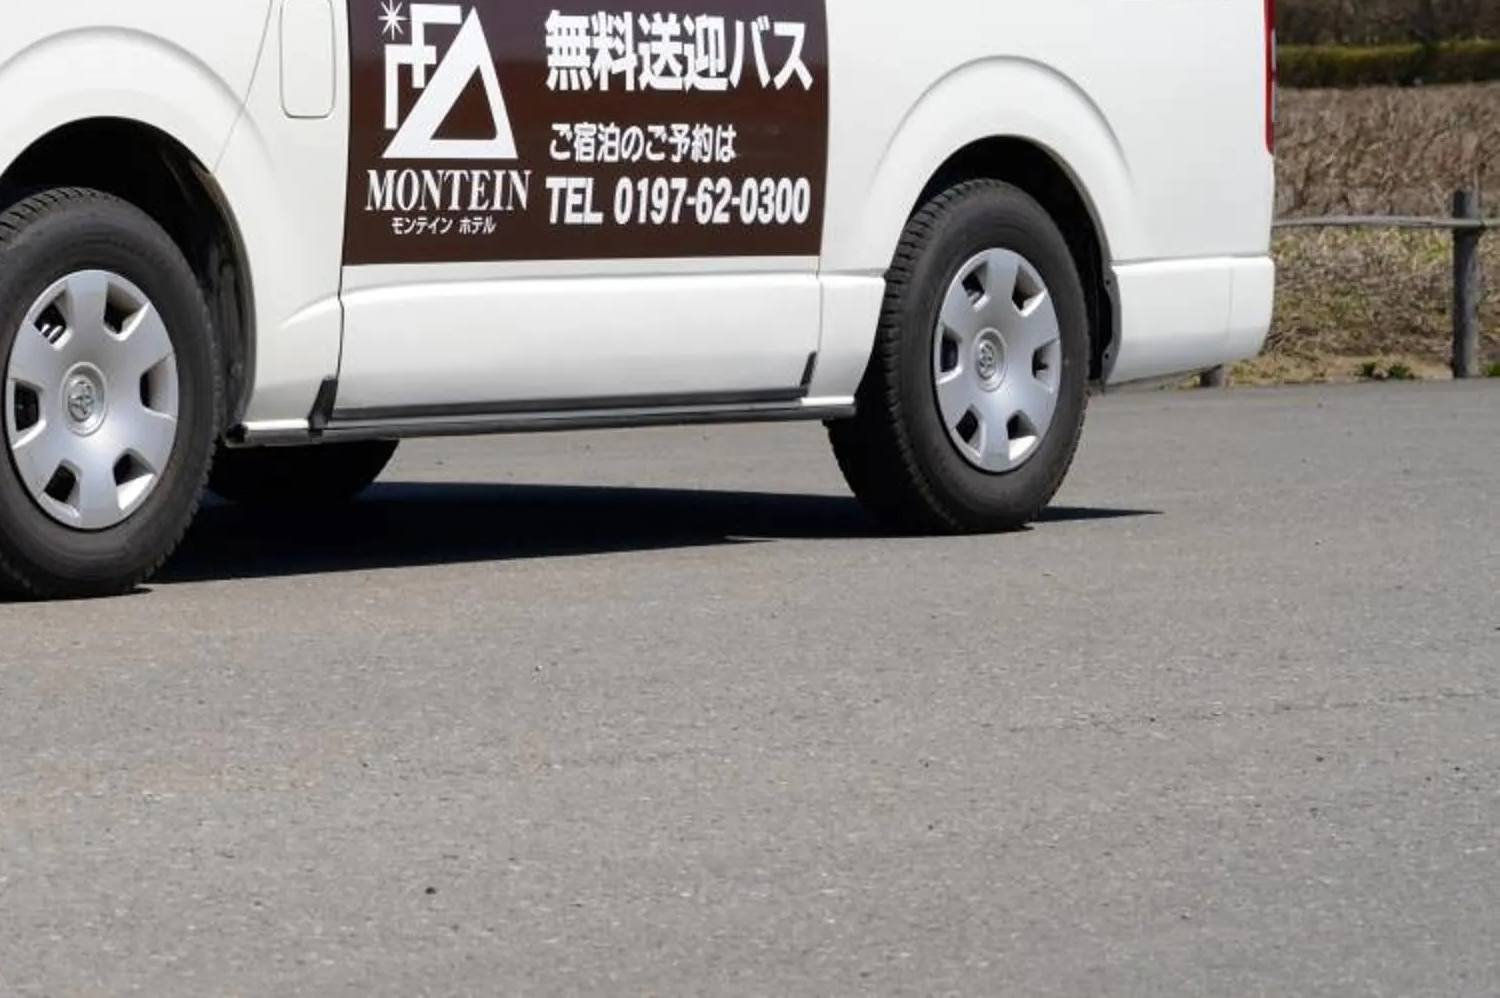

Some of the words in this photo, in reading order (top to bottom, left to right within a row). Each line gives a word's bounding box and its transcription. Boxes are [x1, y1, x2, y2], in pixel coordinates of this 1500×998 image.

[544, 9, 813, 92] 無料送迎バス
[549, 121, 737, 163] ご宿泊のご予約は
[364, 168, 532, 211] MONTEIN
[545, 176, 604, 224] TEL
[613, 176, 811, 225] 0197-62-0300
[458, 216, 497, 235] ホテル
